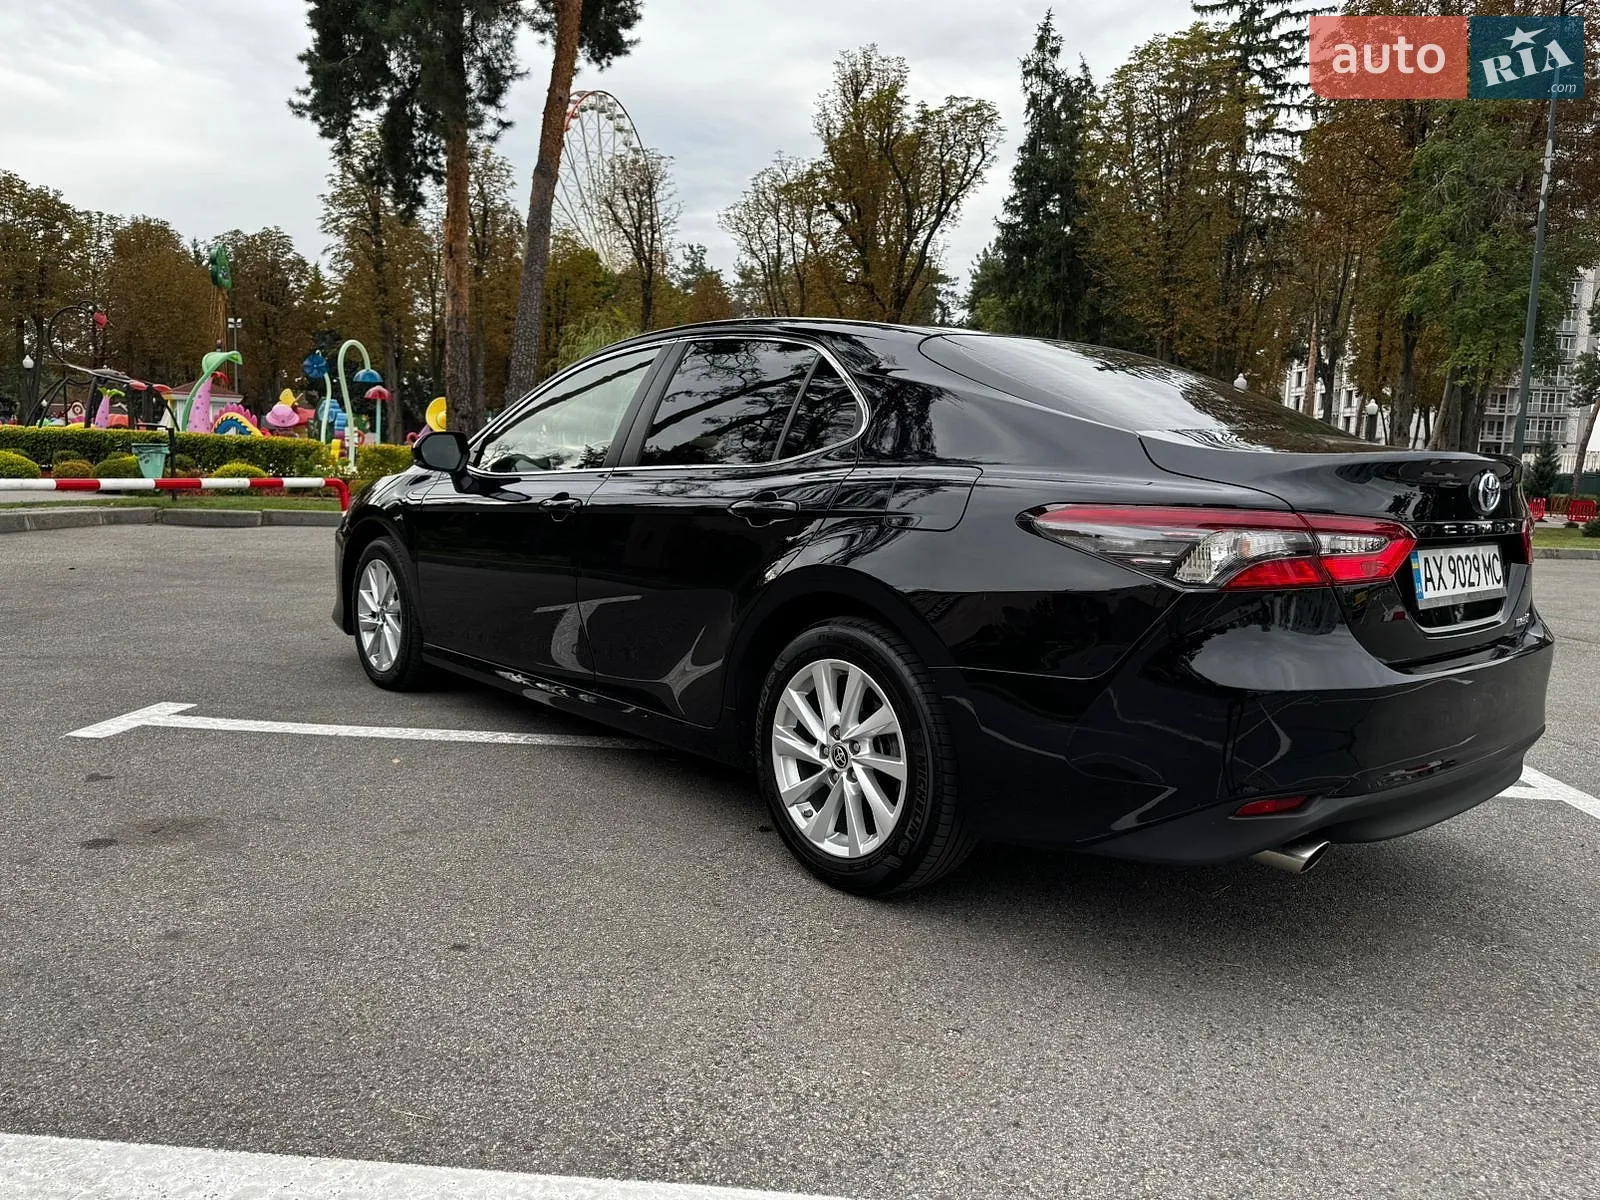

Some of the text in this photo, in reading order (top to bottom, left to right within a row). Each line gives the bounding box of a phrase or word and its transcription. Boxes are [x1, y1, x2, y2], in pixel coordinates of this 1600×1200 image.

[1424, 552, 1502, 592] AX 9029 MC
